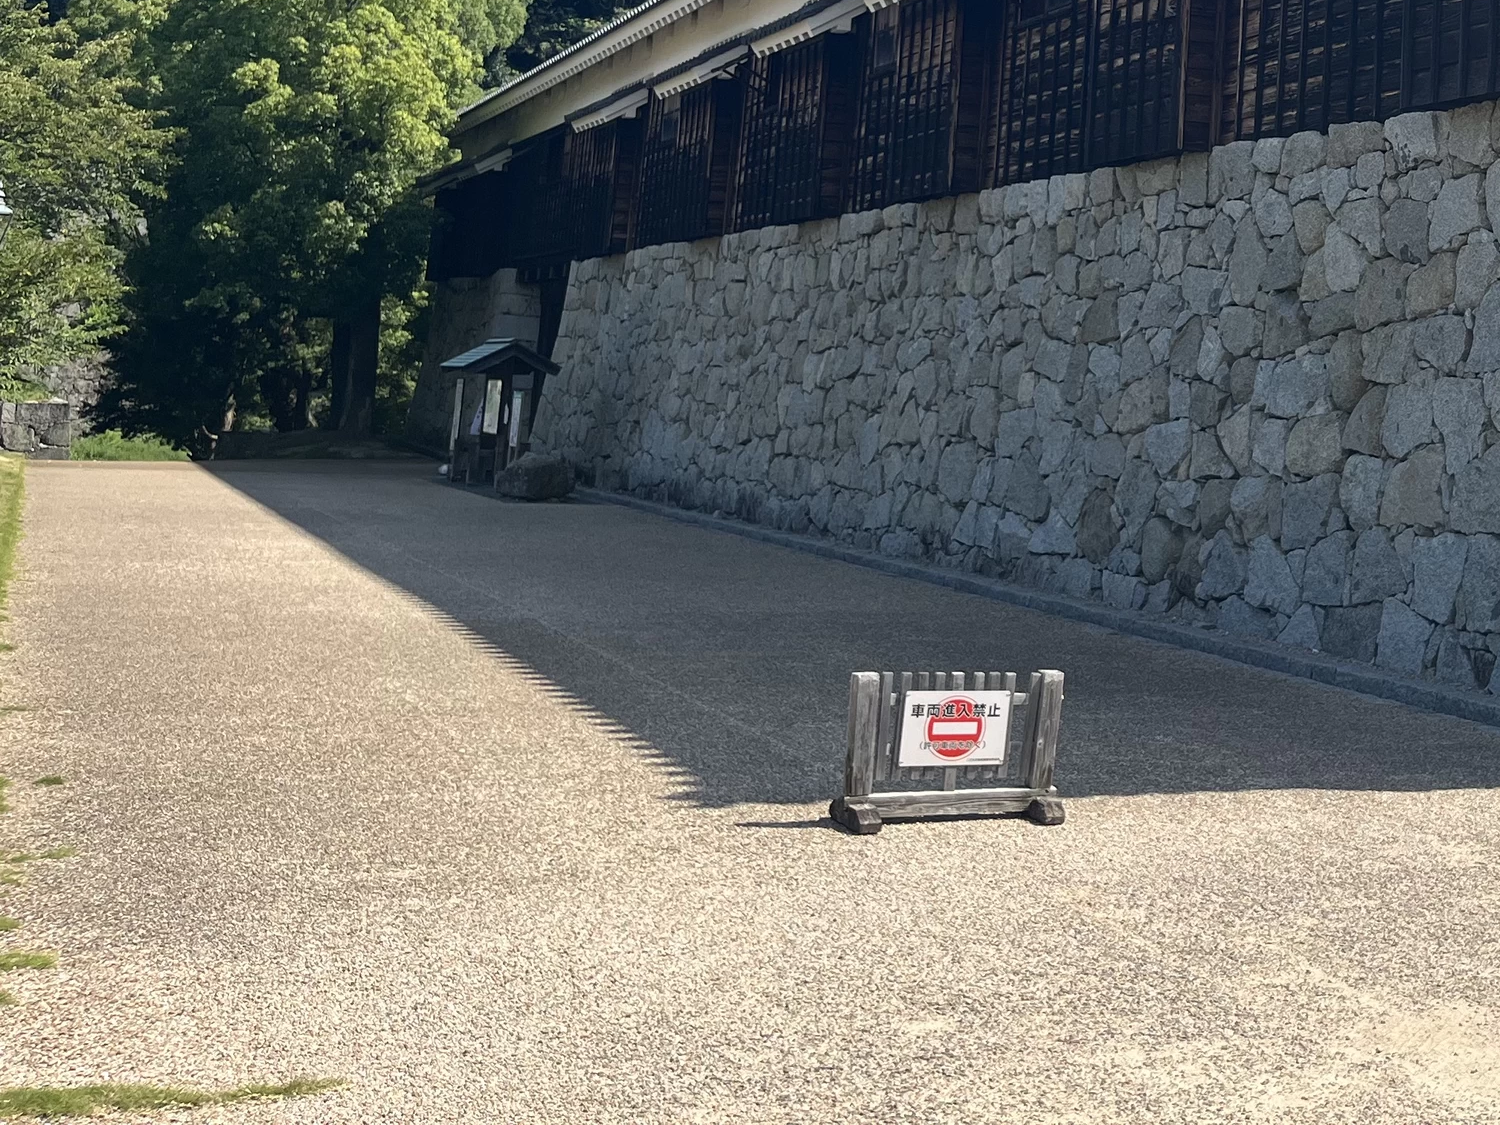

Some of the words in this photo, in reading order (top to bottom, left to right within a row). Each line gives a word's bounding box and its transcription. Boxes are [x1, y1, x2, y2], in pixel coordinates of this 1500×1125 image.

[911, 703, 1001, 718] 車両進入禁止
